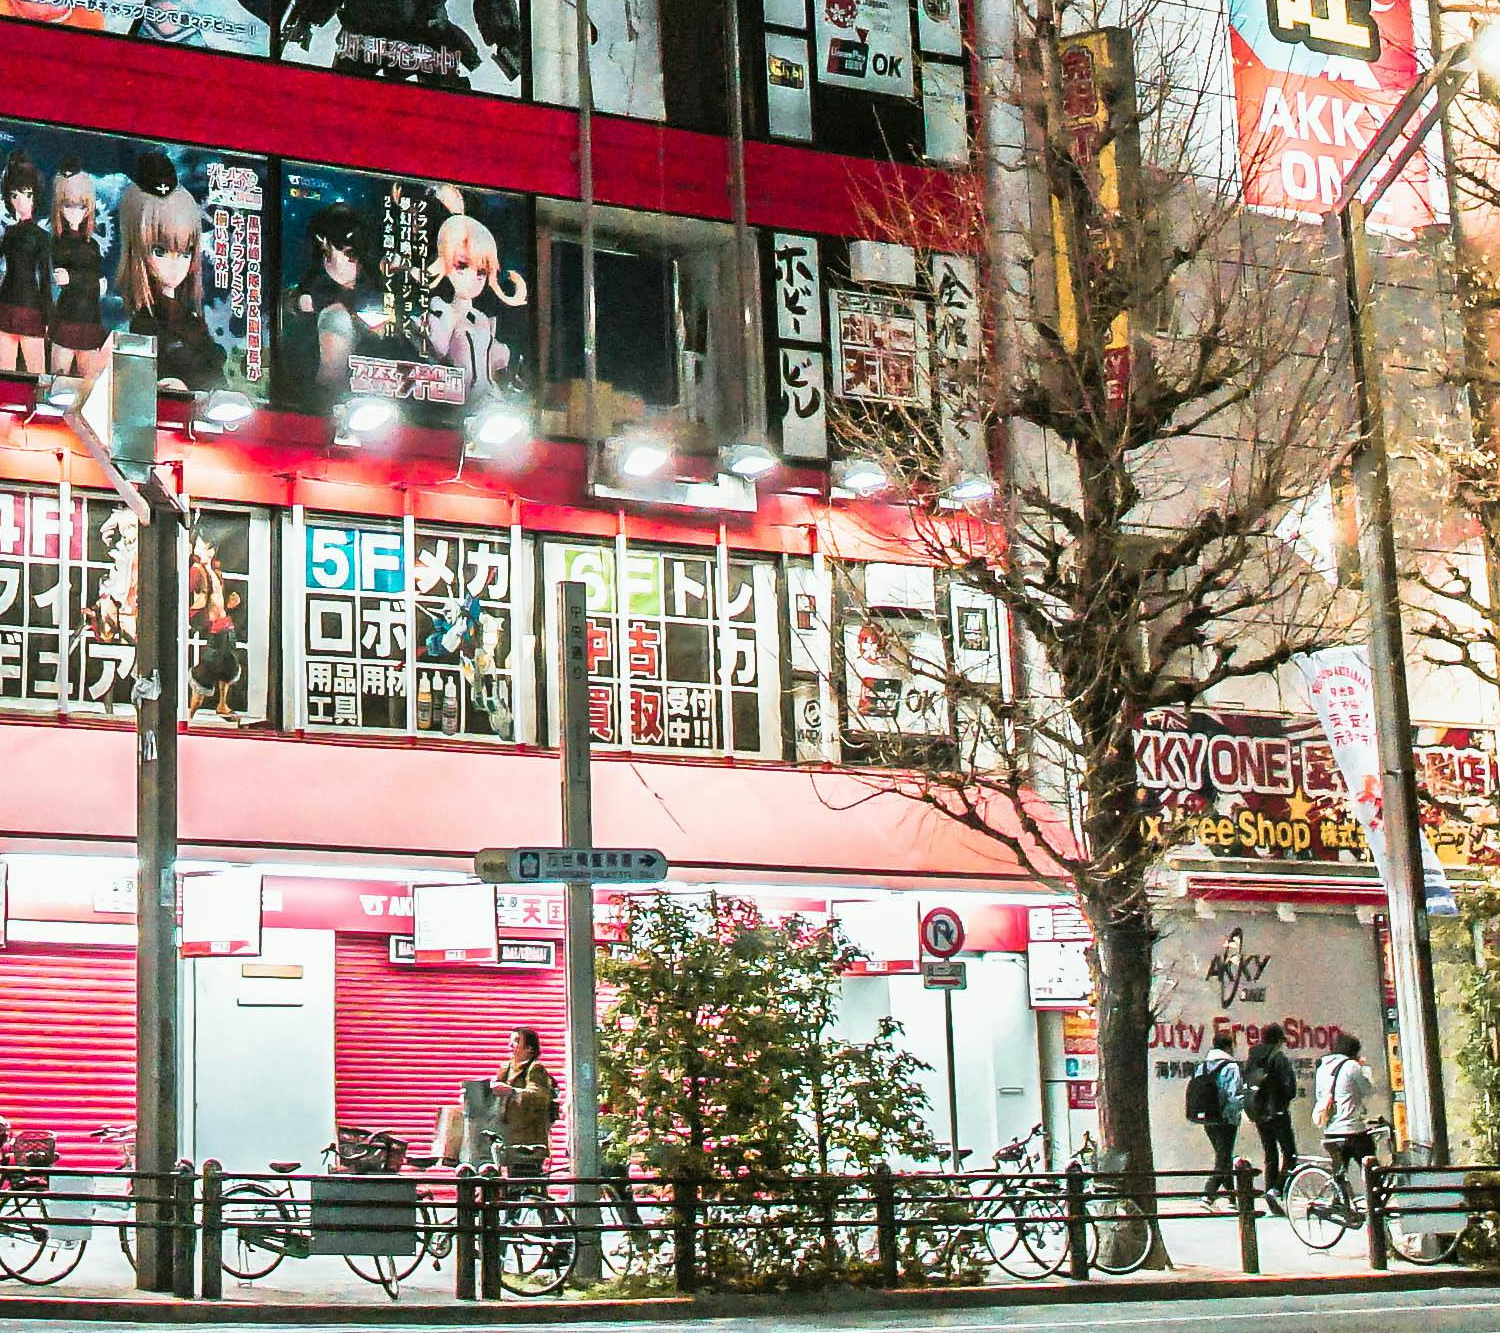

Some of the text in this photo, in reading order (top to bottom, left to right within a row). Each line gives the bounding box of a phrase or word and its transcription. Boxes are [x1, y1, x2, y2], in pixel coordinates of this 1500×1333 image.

[872, 52, 902, 79] OK
[774, 244, 809, 333] ホビー
[309, 528, 402, 591] 5F
[416, 540, 508, 598] メカ
[308, 597, 406, 658] ロボ
[308, 694, 358, 727] 工具
[666, 686, 713, 718] 受付
[905, 688, 939, 715] OK
[1211, 735, 1292, 790] ONE
[1237, 808, 1312, 851] Shop
[522, 898, 566, 926] 天国
